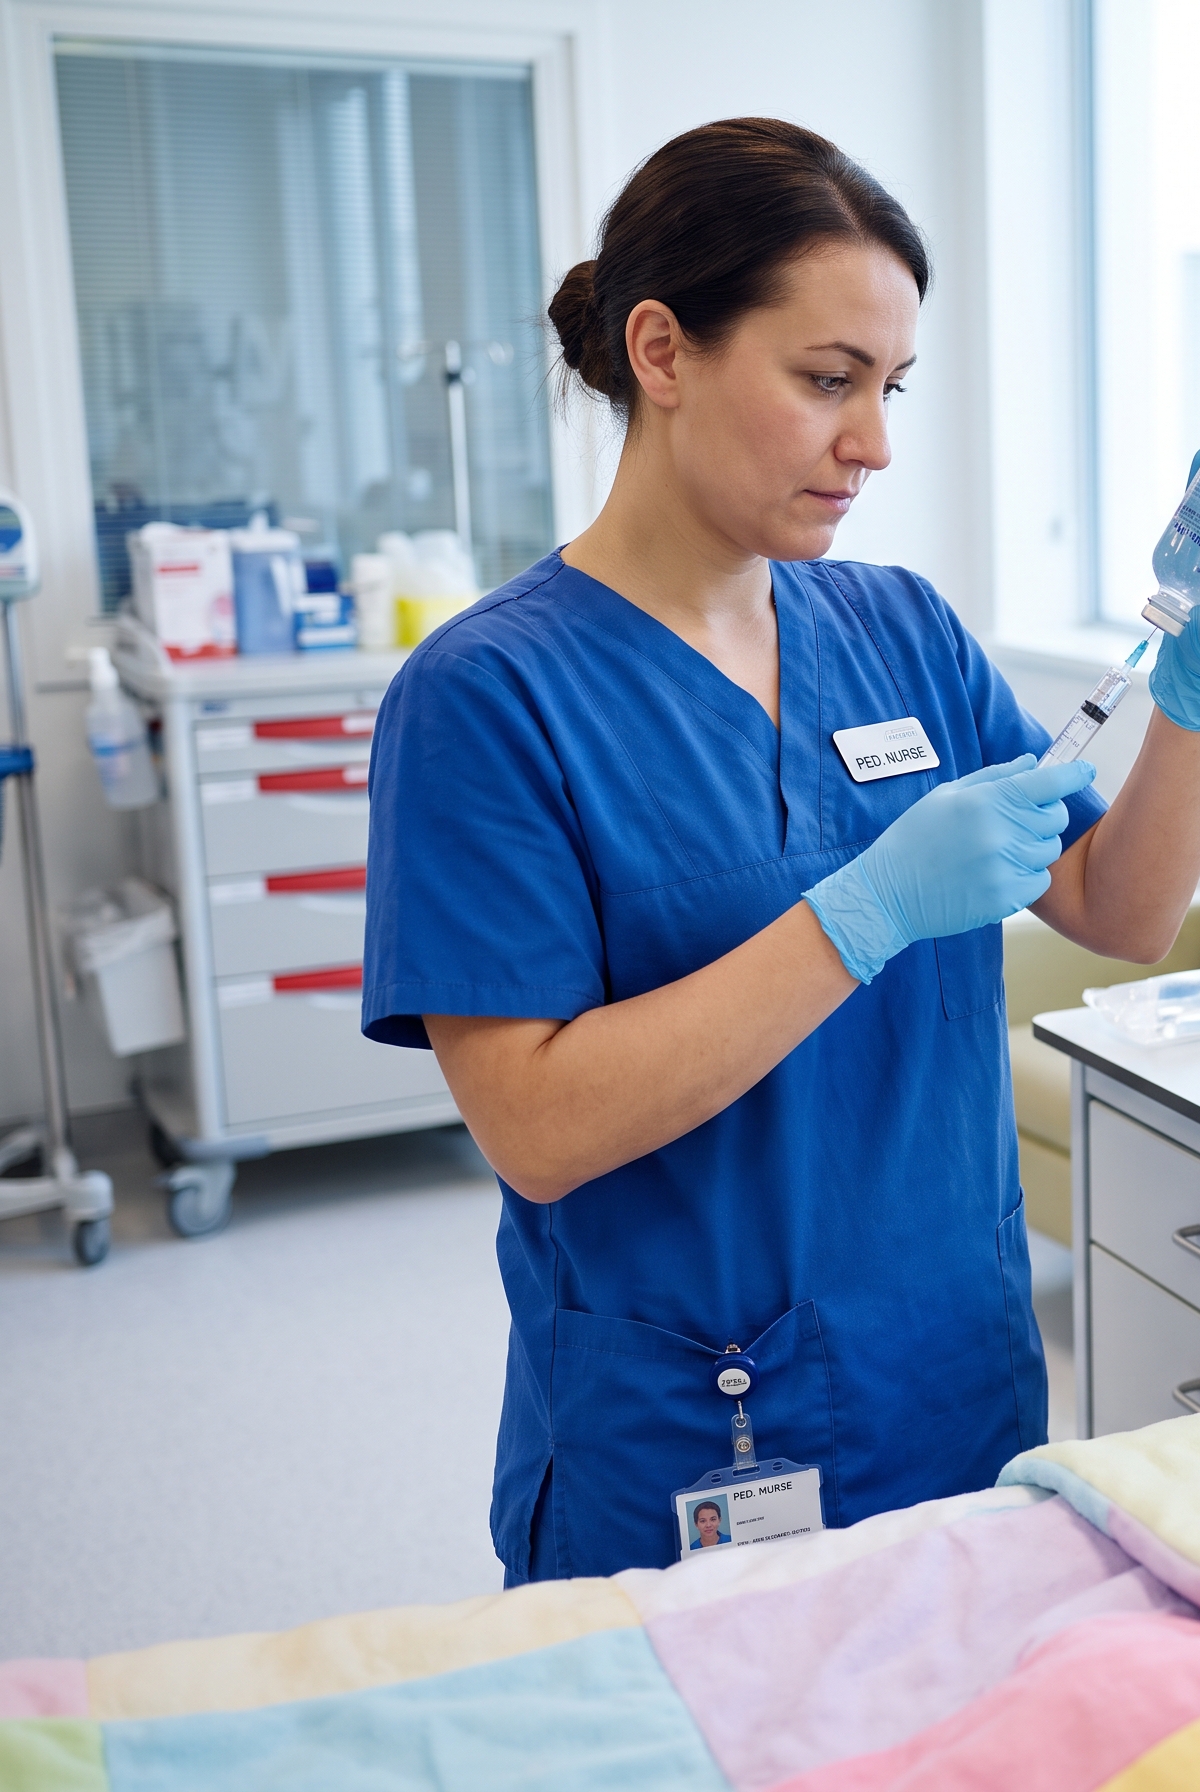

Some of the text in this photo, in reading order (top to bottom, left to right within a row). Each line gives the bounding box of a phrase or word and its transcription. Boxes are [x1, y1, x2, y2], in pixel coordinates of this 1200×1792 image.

[856, 746, 927, 770] PED. NURSE
[733, 1481, 793, 1501] PED. MURSE
